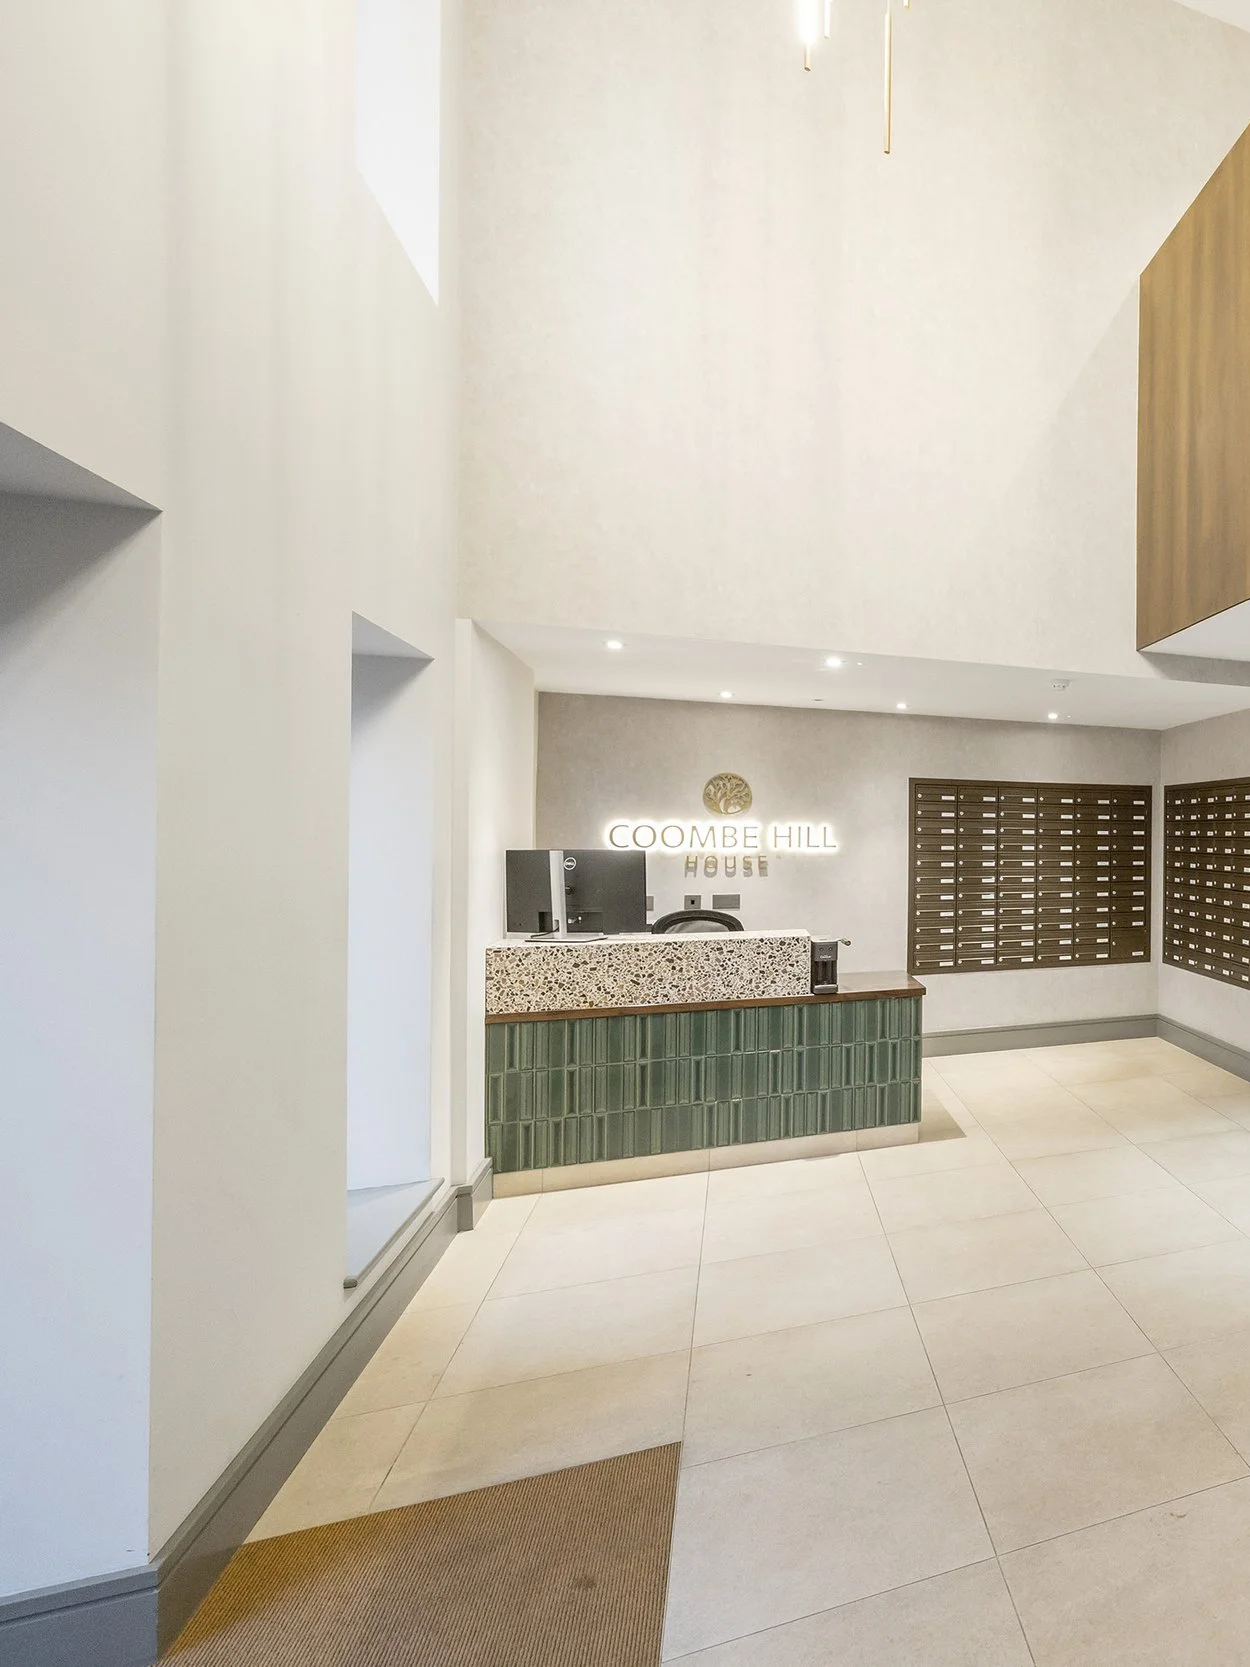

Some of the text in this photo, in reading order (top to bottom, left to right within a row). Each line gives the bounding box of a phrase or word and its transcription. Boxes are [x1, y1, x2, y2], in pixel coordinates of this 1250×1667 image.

[609, 824, 837, 849] COOMBE HILL
[684, 855, 767, 871] HOUSE
